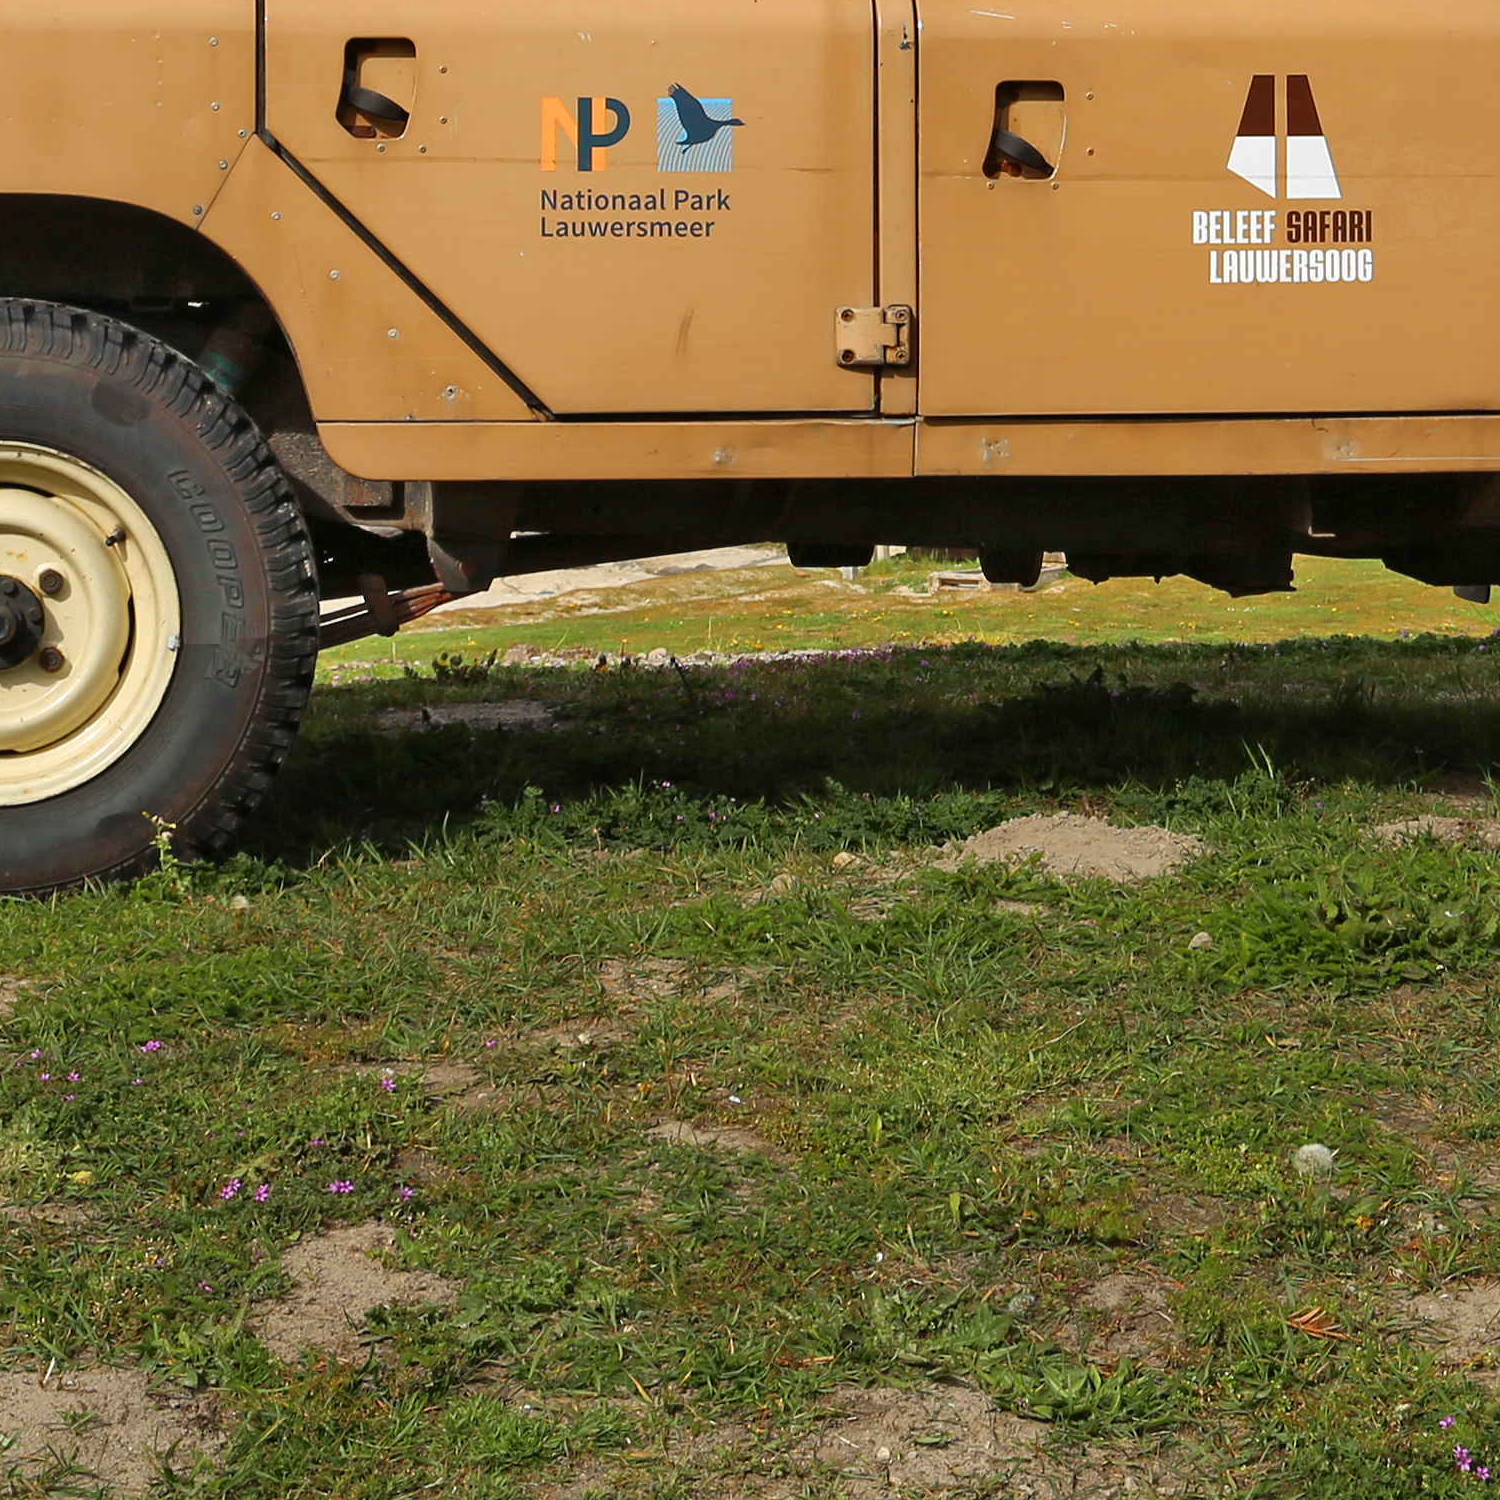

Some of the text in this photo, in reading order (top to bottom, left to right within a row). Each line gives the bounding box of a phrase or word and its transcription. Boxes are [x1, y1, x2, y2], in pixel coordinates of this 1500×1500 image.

[540, 189, 731, 211] Nationaal Park
[540, 217, 715, 237] Lauwersmeer
[1192, 210, 1372, 244] BELEEF SAFARI
[1209, 248, 1374, 283] LAUWERSOOG
